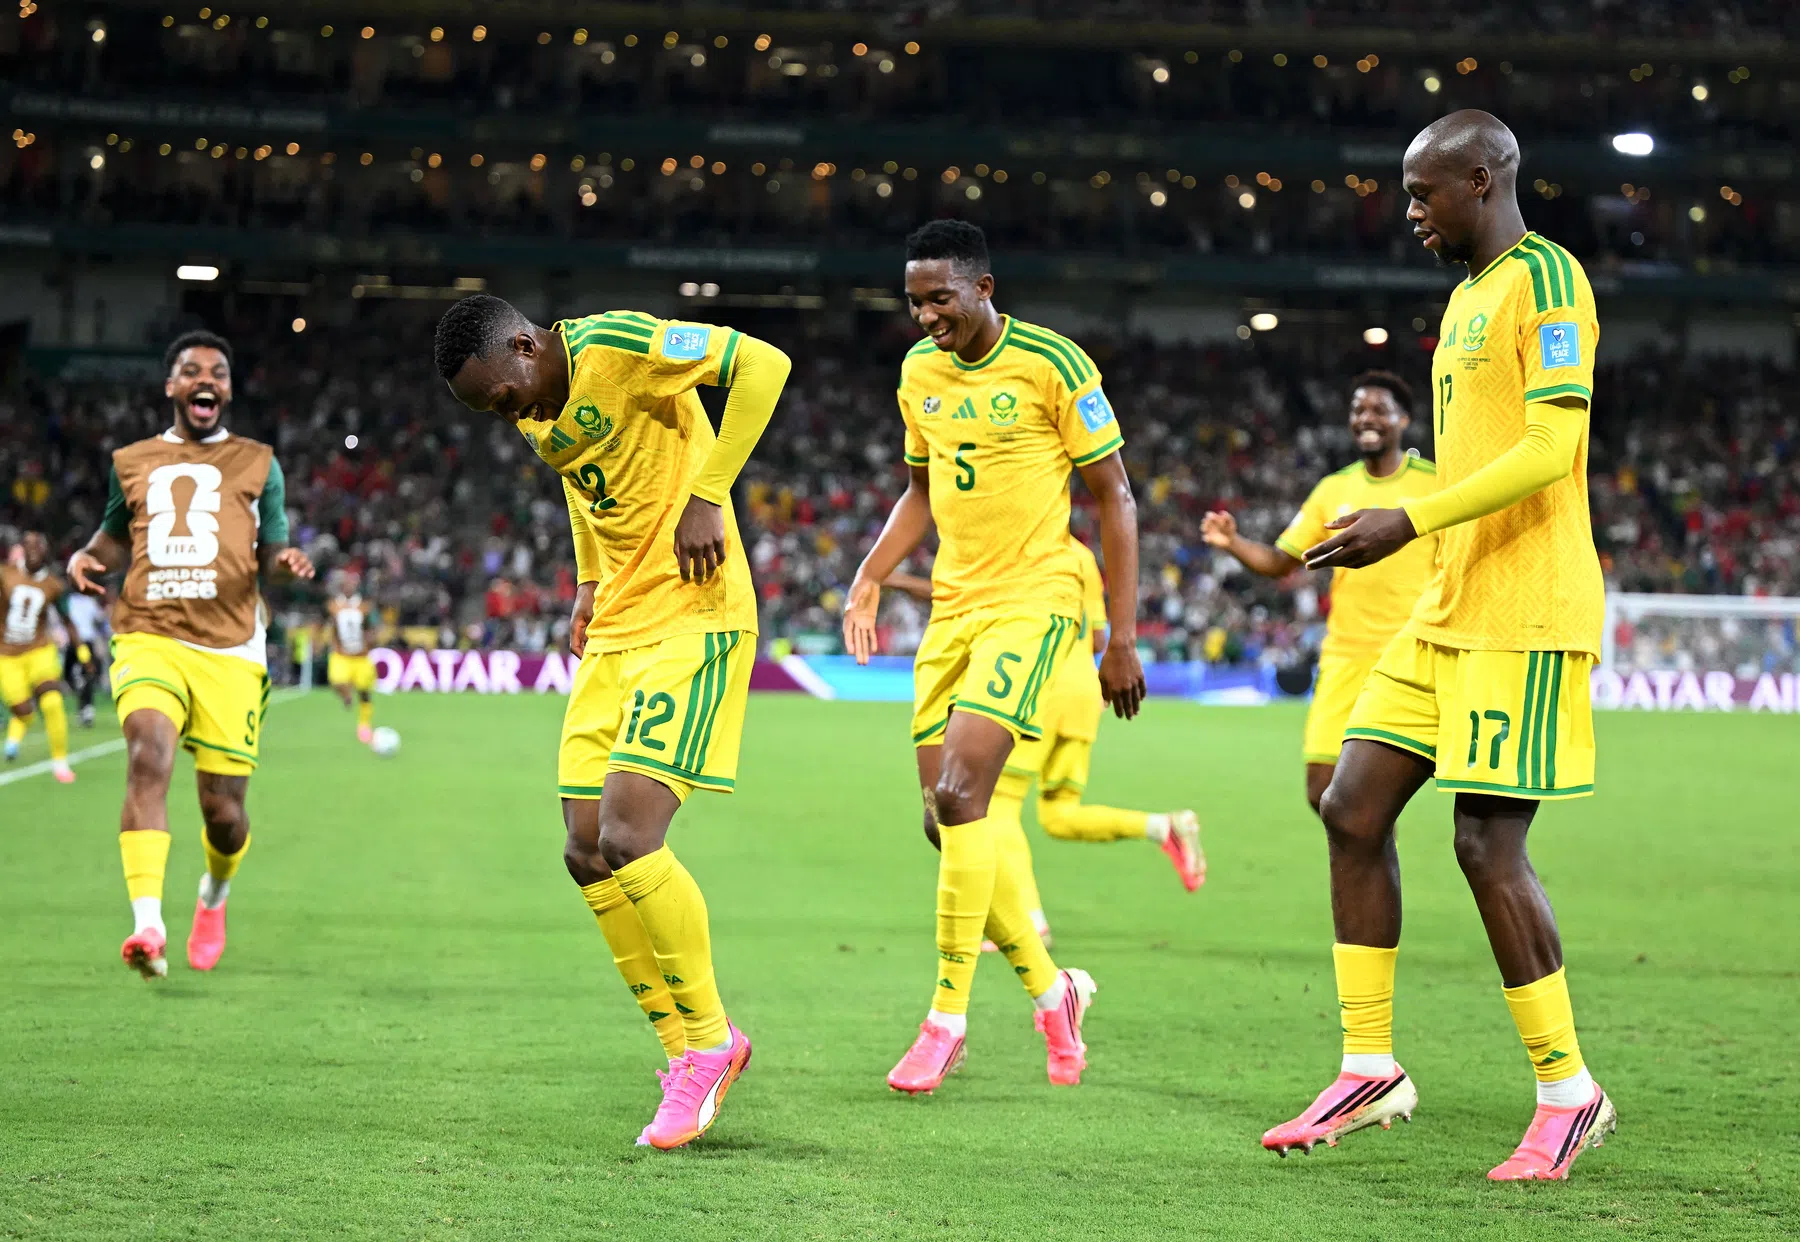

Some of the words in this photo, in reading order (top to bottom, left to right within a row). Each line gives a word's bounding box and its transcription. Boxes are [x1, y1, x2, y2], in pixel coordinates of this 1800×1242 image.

[1439, 374, 1452, 436] 17
[568, 463, 618, 513] 12
[955, 442, 977, 491] 5
[165, 543, 198, 554] FIFA
[146, 580, 219, 601] 2026
[148, 568, 191, 583] WORLD
[191, 568, 218, 581] CUP
[368, 647, 521, 695] QATAR
[987, 651, 1022, 699] 5
[1590, 669, 1736, 712] QATAR
[625, 689, 676, 751] 12
[1467, 709, 1511, 770] 17
